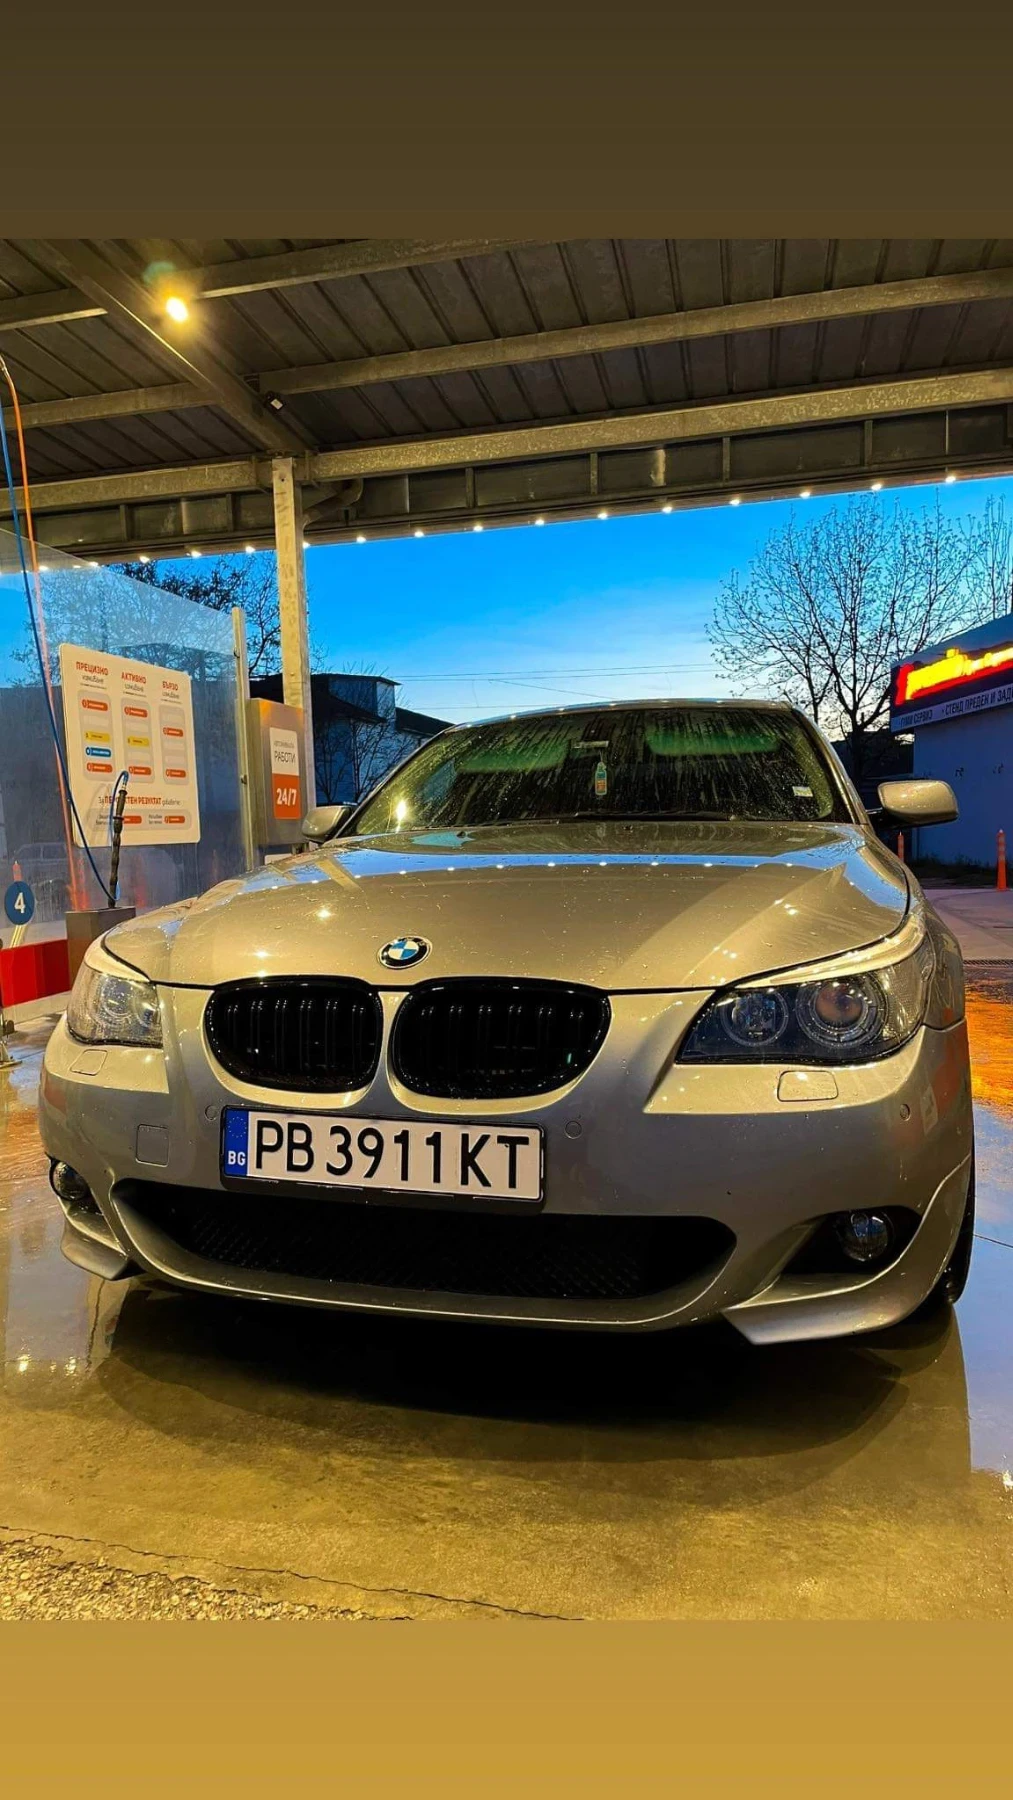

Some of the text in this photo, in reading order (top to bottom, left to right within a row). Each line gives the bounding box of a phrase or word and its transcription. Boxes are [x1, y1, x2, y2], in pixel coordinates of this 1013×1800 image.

[76, 661, 108, 675] ПРЕЦИЗНО
[121, 672, 146, 684] АКТИВНО
[162, 681, 179, 691] БЪРЗО
[945, 701, 964, 716] СТЕНД
[965, 694, 989, 710] ПРЕДЕН
[990, 692, 996, 704] И
[913, 710, 933, 724] СЕРВИЗ
[274, 751, 296, 763] РАБОТИ
[276, 788, 297, 806] 24/7
[14, 892, 26, 914] 4
[227, 1150, 246, 1166] BG
[256, 1120, 530, 1189] PB 3911 KT
